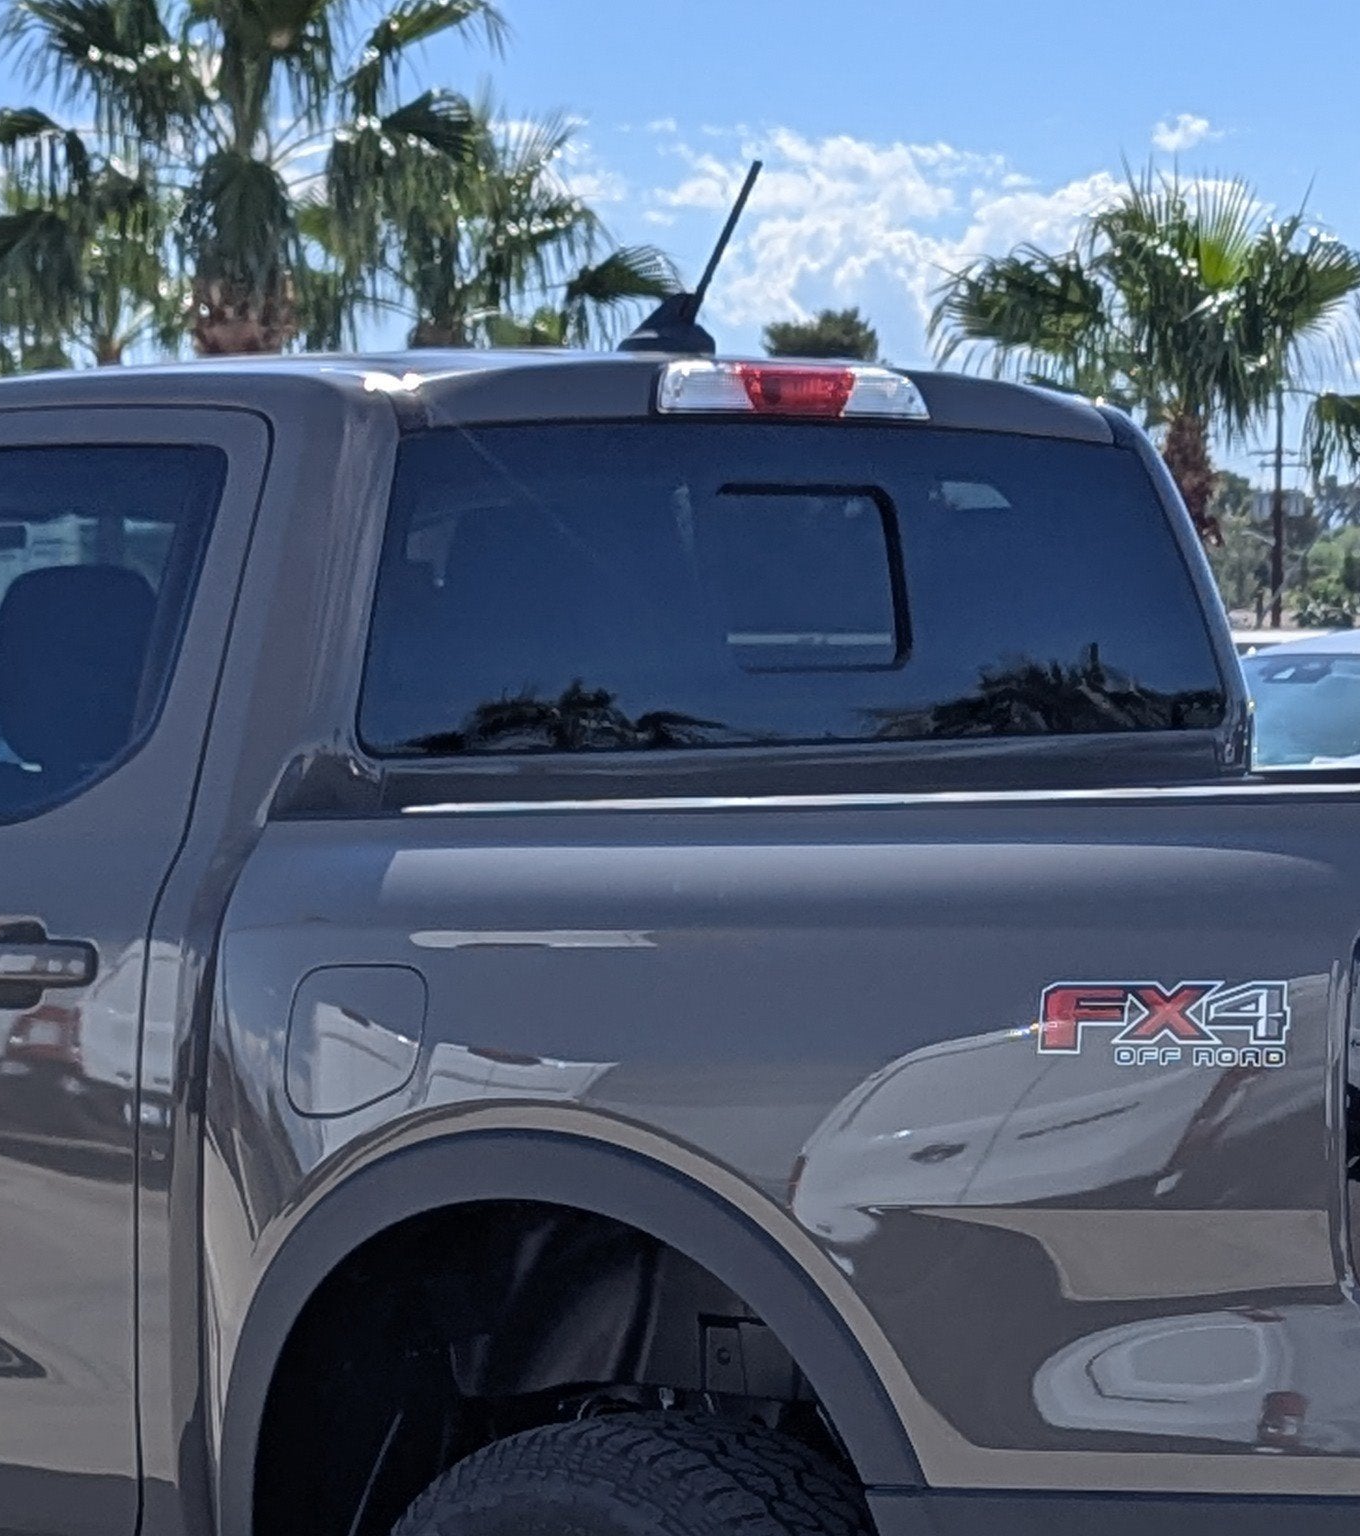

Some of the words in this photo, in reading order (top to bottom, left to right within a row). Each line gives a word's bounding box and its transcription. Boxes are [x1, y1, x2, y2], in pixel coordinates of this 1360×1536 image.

[1038, 981, 1290, 1054] FX4
[1114, 1048, 1181, 1066] OFF
[1193, 1047, 1286, 1067] ROAD
